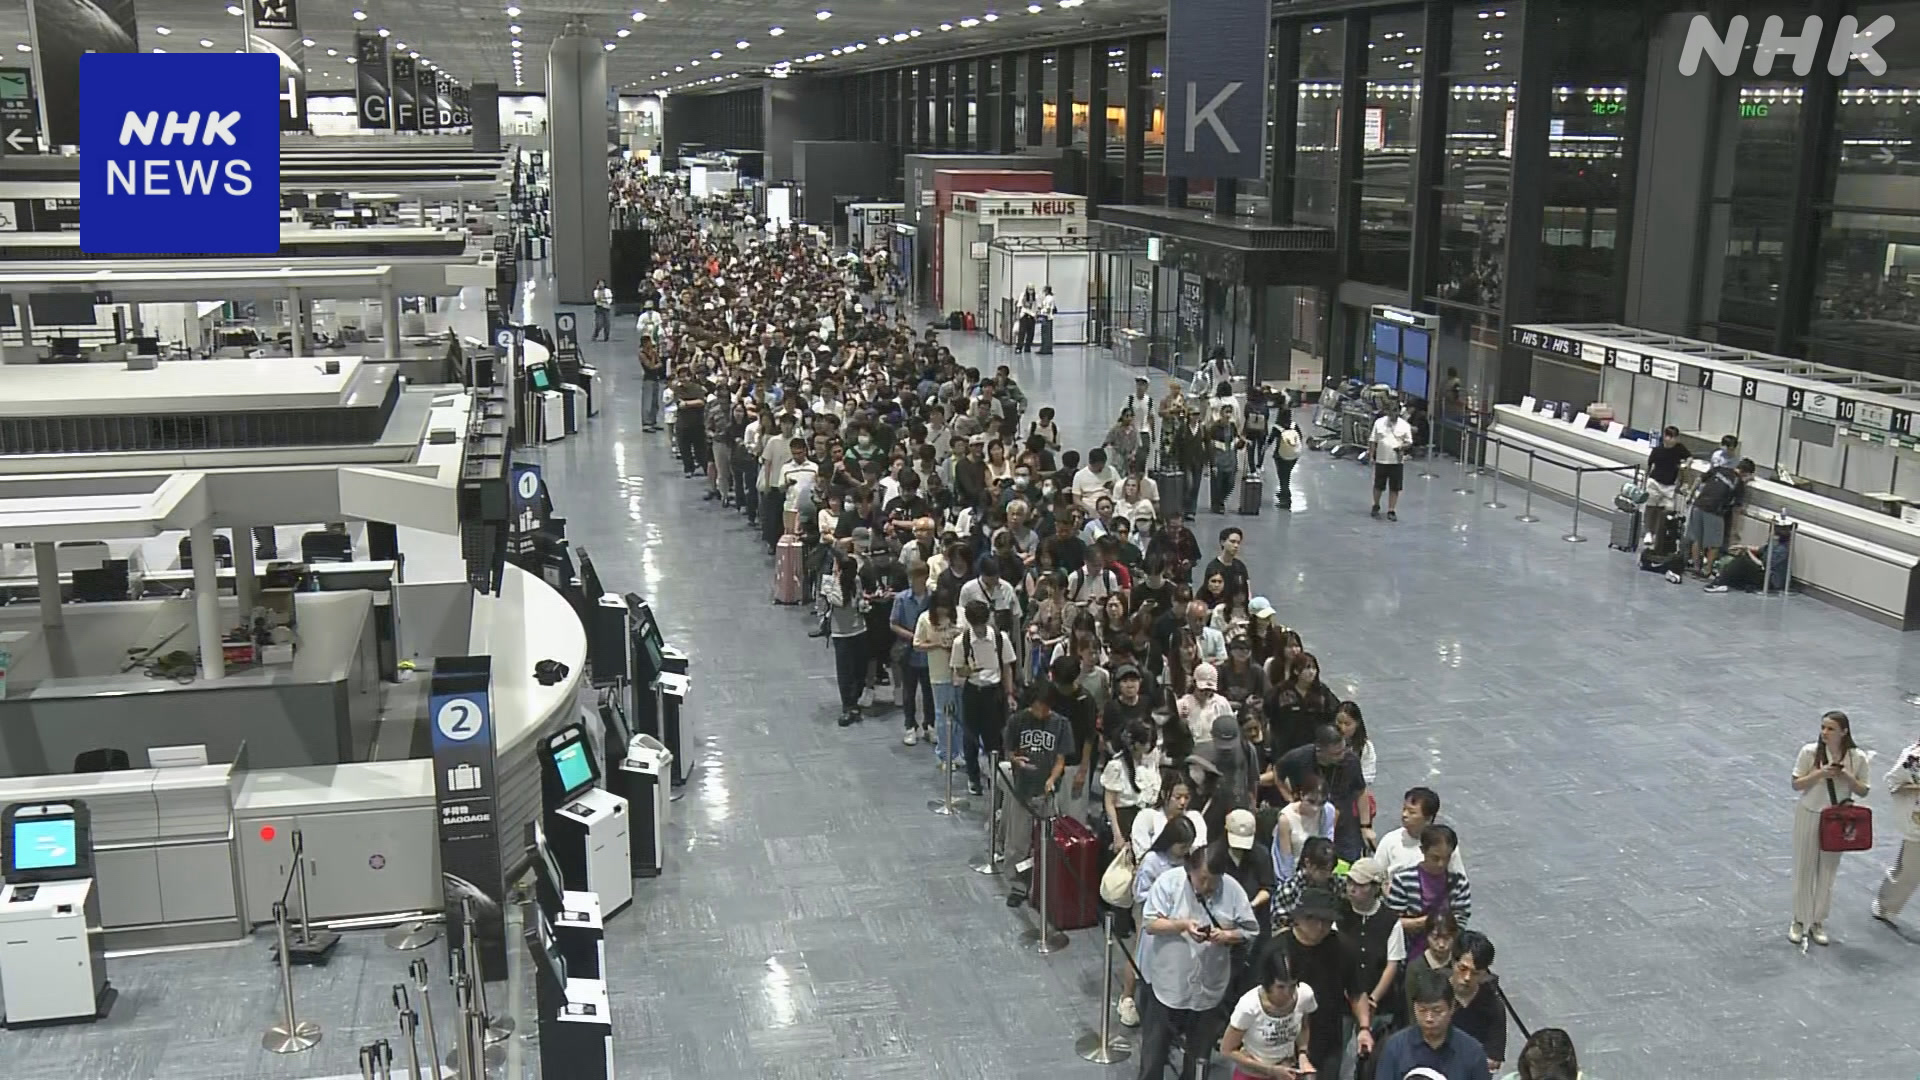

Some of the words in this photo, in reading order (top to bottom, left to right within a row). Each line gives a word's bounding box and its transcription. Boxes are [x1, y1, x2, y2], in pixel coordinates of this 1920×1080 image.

[364, 95, 386, 121] G
[399, 104, 413, 125] F
[423, 107, 435, 125] E
[1739, 104, 1769, 117] ING
[440, 110, 451, 125] D
[452, 111, 462, 125] C
[1184, 81, 1244, 153] K
[1031, 201, 1076, 215] NEWS
[1512, 329, 1518, 342] 1
[1541, 335, 1549, 349] 2
[1573, 342, 1581, 356] 3
[1608, 350, 1615, 364] 5
[1643, 358, 1651, 373] 6
[1703, 371, 1711, 386] 7
[1745, 381, 1754, 396] 8
[1792, 390, 1800, 406] 9
[1840, 401, 1854, 419] 10
[1895, 412, 1910, 431] 11
[524, 477, 531, 493] 1
[451, 706, 470, 732] 2
[443, 814, 490, 824] BAGGAGE
